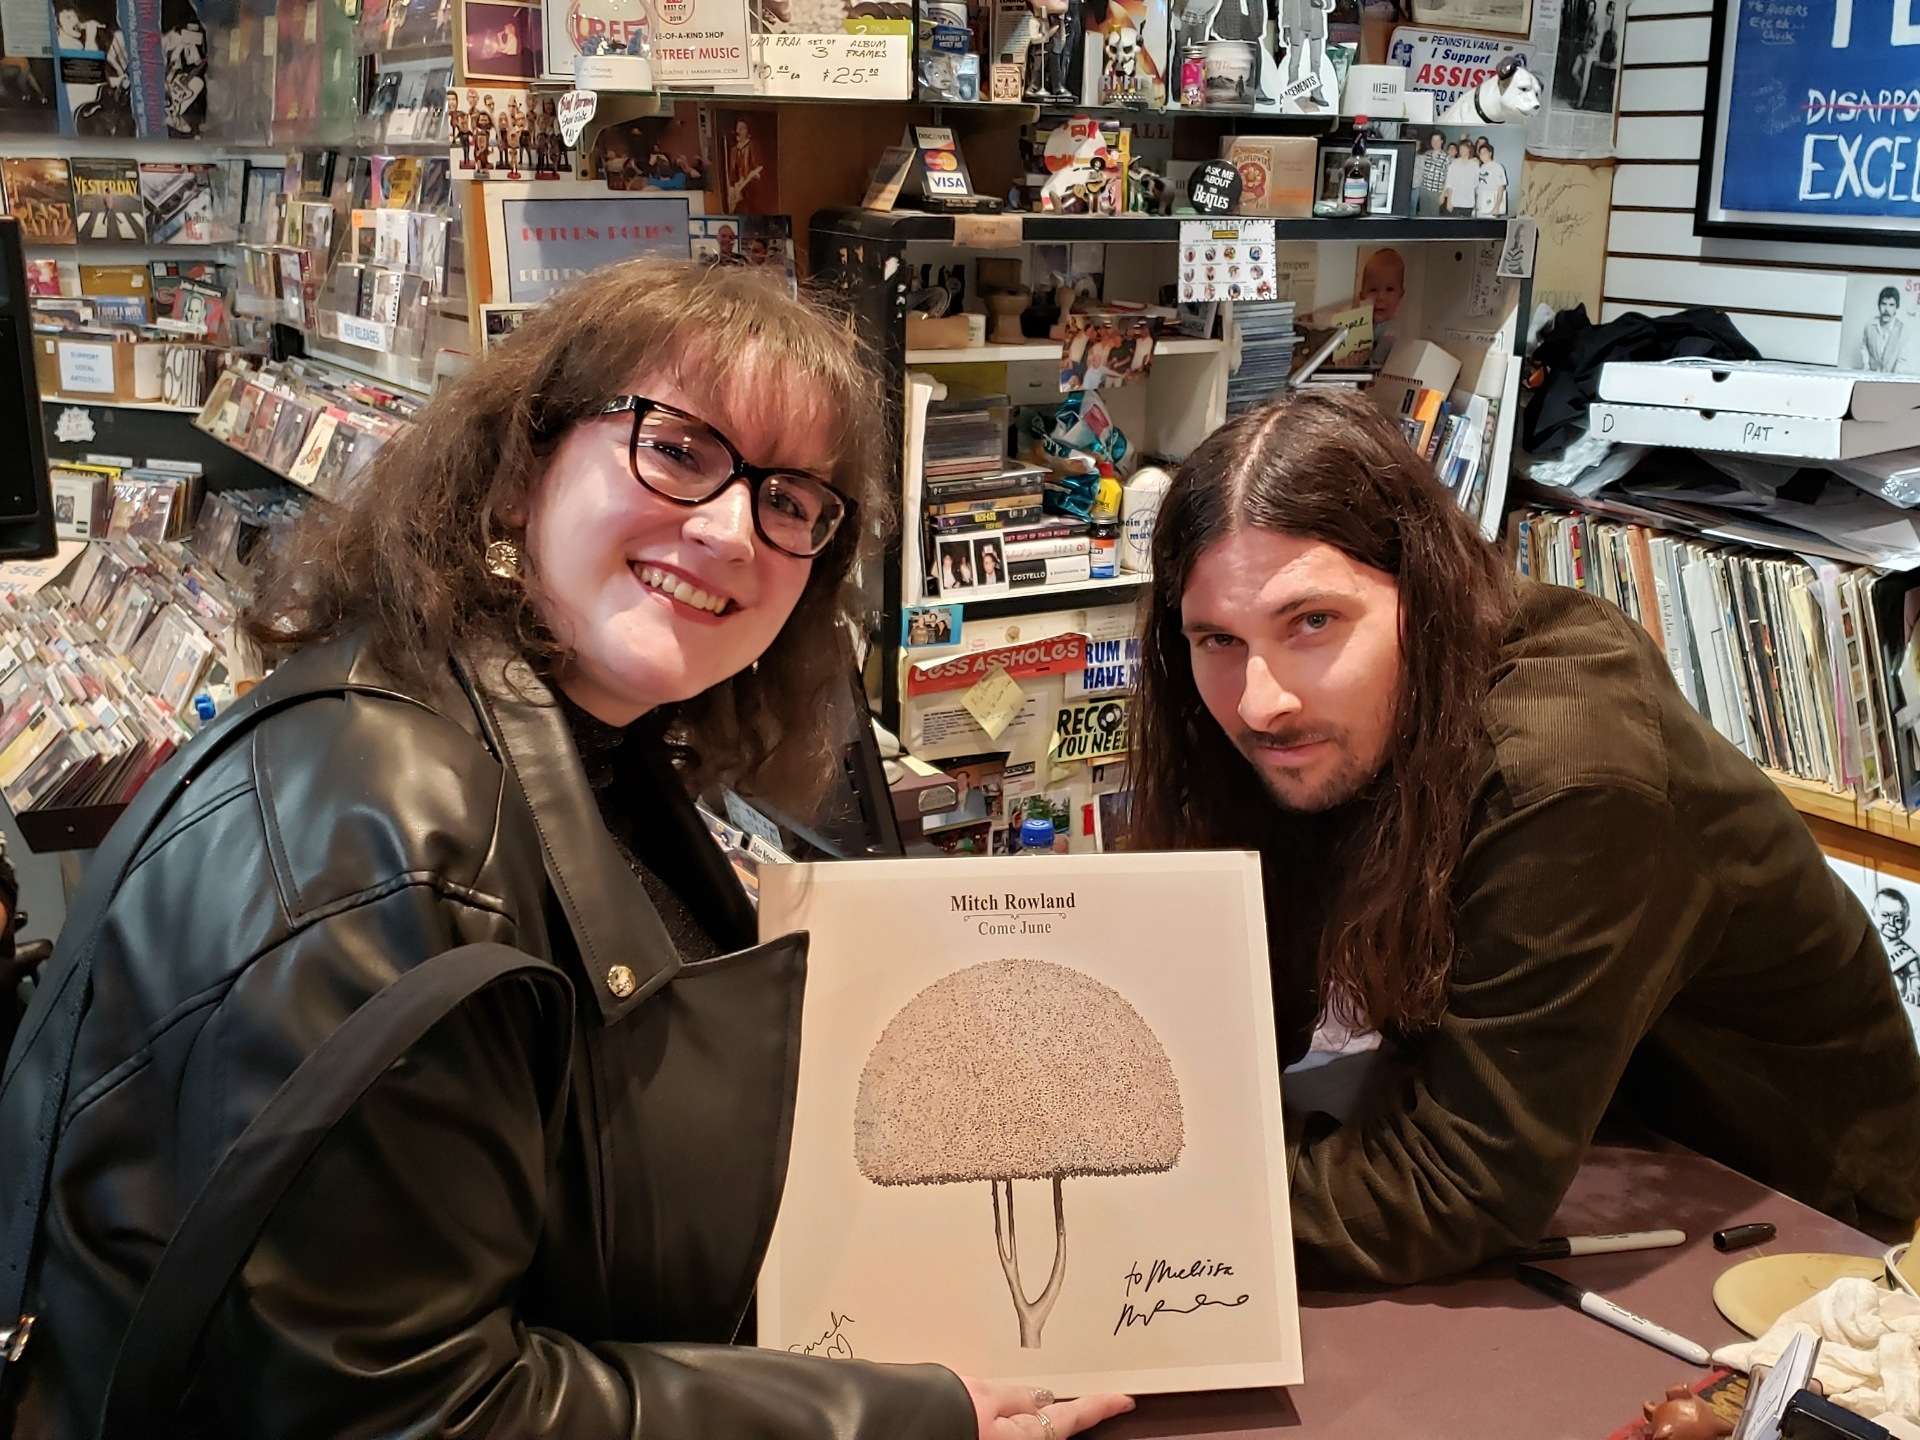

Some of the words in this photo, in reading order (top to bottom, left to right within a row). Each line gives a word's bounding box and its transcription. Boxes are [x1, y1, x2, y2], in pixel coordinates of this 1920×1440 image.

[850, 40, 887, 48] ALBUM
[1432, 35, 1499, 51] PENNSYLVANIA
[656, 48, 695, 60] STREET
[699, 47, 740, 58] MUSIC
[812, 47, 829, 58] 3
[845, 50, 887, 58] FRAMES
[1442, 48, 1491, 64] Support
[1205, 165, 1221, 176] ASK
[1221, 169, 1235, 181] ME
[74, 176, 138, 196] YESTERDAY
[933, 177, 964, 188] VISA
[1204, 176, 1231, 189] ABOUT
[1193, 184, 1229, 210] BEATLES
[1743, 422, 1774, 444] PAT
[1012, 571, 1046, 581] COSTELLO
[1083, 665, 1125, 689] HAVE
[1058, 735, 1088, 758] YOU
[950, 894, 998, 911] Mitch
[1005, 892, 1076, 909] Rowland
[978, 921, 1016, 935] Come
[1020, 920, 1051, 934] June
[1144, 1259, 1234, 1293] Melissa
